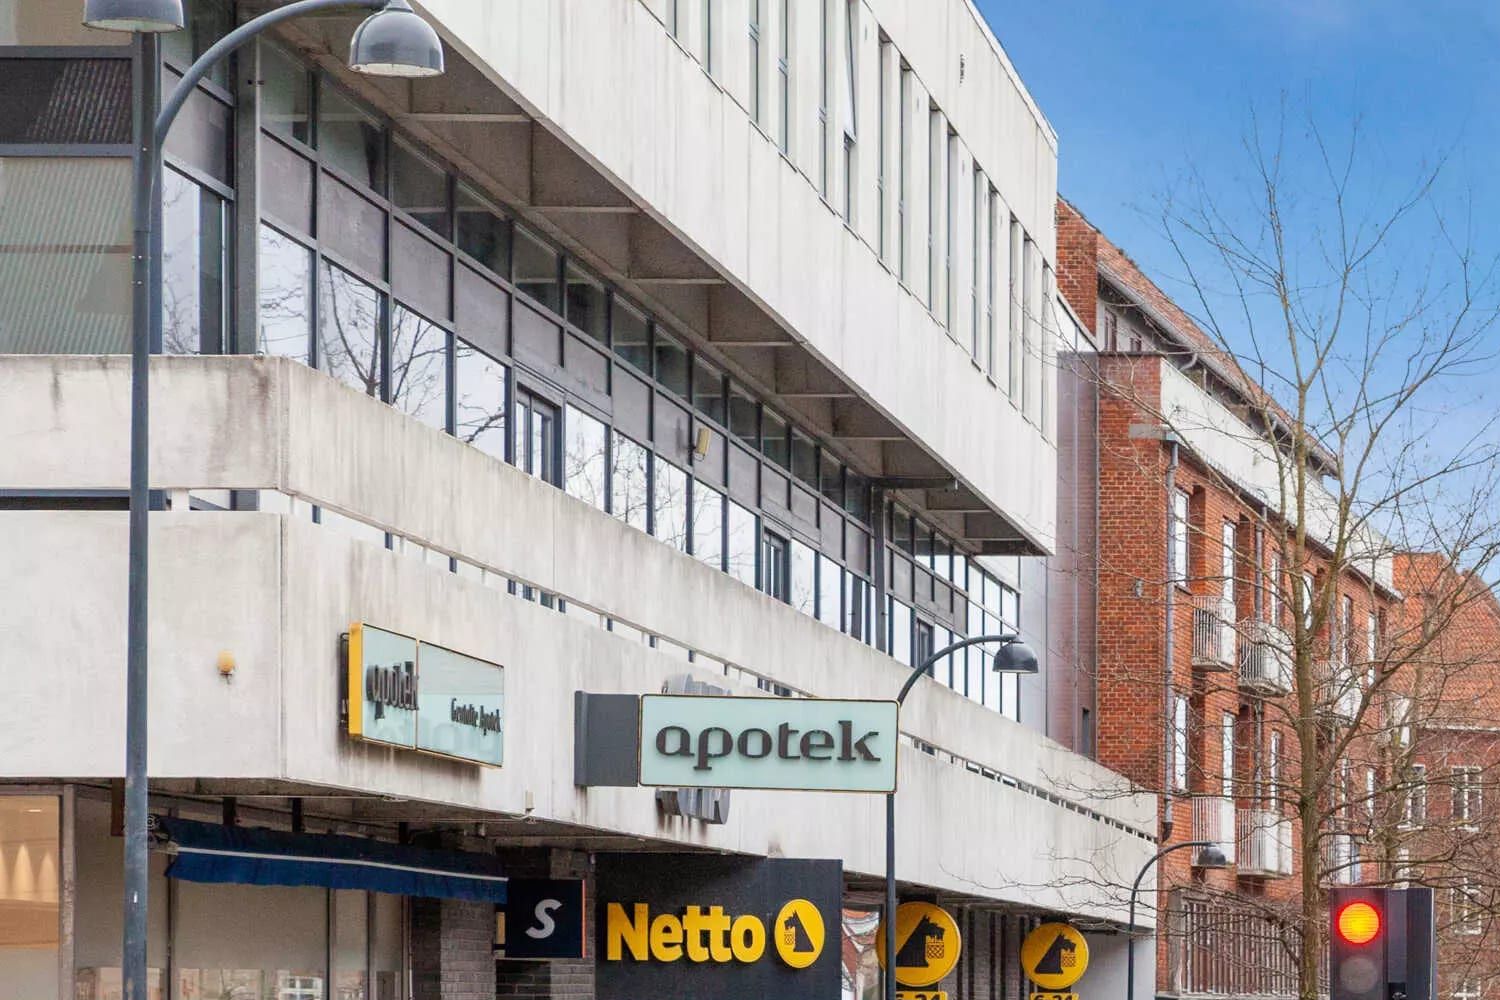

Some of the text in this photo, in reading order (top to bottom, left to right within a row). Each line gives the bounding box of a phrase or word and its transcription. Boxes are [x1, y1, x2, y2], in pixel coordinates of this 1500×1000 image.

[655, 720, 881, 771] apotek
[525, 899, 563, 940] S
[606, 902, 767, 963] Netto
